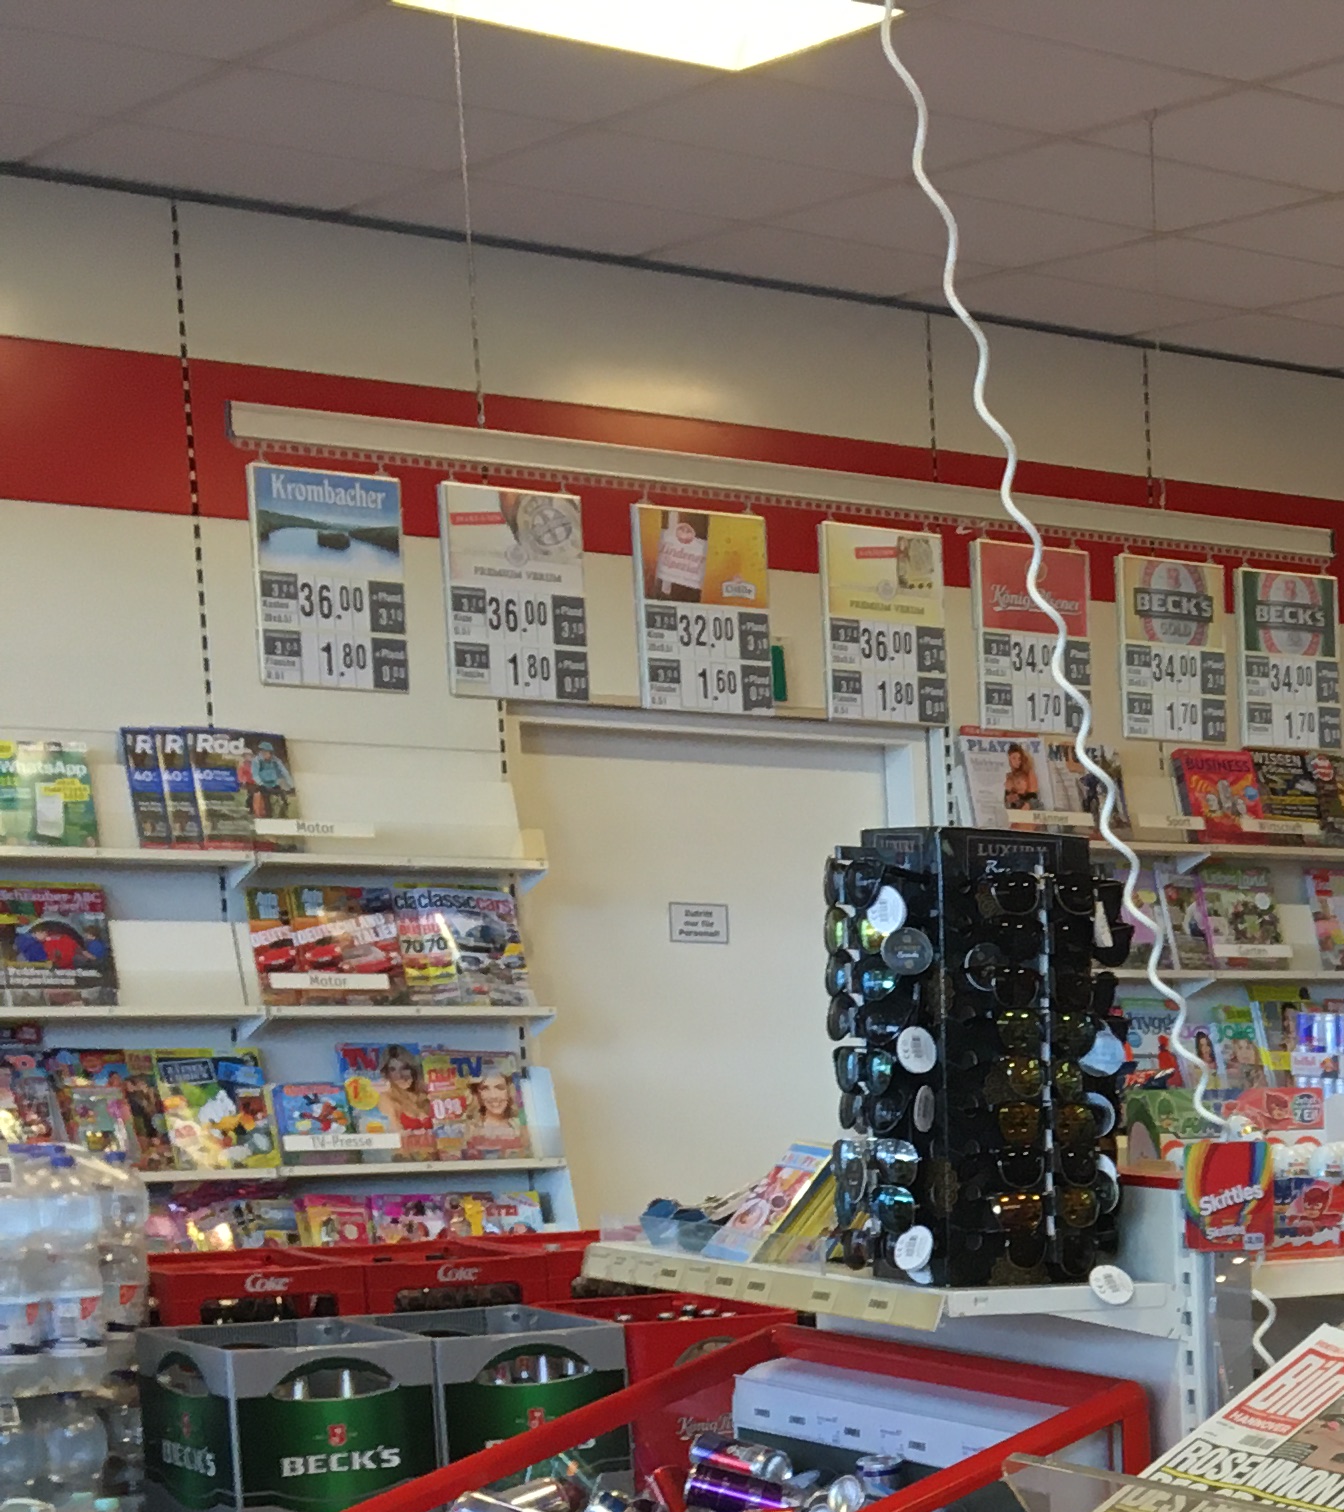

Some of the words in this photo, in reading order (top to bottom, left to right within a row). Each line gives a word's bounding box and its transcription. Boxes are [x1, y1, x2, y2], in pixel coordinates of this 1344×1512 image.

[269, 473, 387, 511] Krombacher
[300, 582, 364, 620] 36.00
[488, 595, 548, 633] 36.00
[1135, 591, 1212, 619] BECK'S
[1254, 605, 1325, 627] BECK'S
[679, 613, 734, 649] 32.00
[860, 627, 912, 663] 36.00
[321, 641, 367, 677] 1.80
[507, 652, 551, 687] 1.80
[1152, 651, 1198, 684] 34.00
[698, 668, 737, 702] 1.60
[1270, 662, 1314, 694] 34.00
[877, 680, 914, 712] 1.80
[1027, 691, 1061, 724] 1.70
[1166, 701, 1198, 732] 1.70
[966, 738, 1042, 756] PLAYOY
[295, 820, 336, 835] Motor
[308, 974, 349, 987] Motor
[1199, 1183, 1264, 1216] Skittles
[244, 1272, 294, 1293] Coke
[437, 1263, 482, 1283] Coke
[1228, 1410, 1297, 1435] HANNOVER
[161, 1438, 217, 1477] BECK'S
[280, 1443, 401, 1477] BECK'S
